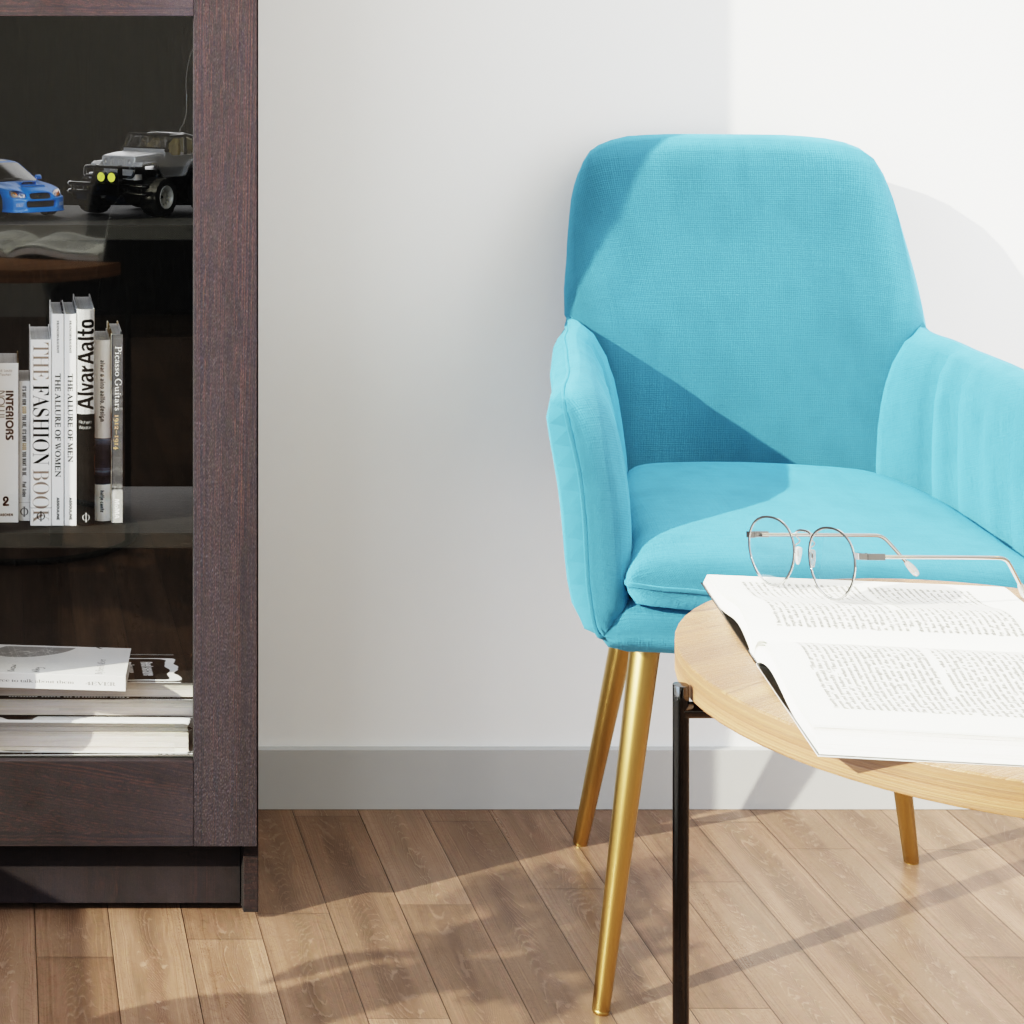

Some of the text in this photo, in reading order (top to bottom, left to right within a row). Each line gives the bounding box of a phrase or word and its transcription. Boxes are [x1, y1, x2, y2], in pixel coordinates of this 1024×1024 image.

[77, 320, 94, 362] Aalto
[114, 346, 122, 377] Picasso
[77, 366, 94, 410] Alvar
[114, 378, 122, 411] Guitars
[6, 391, 14, 440] INTERIORS
[32, 343, 49, 522] THE FASHION BOOK
[55, 430, 61, 441] OF
[67, 429, 73, 441] OF
[2, 496, 9, 506] 2
